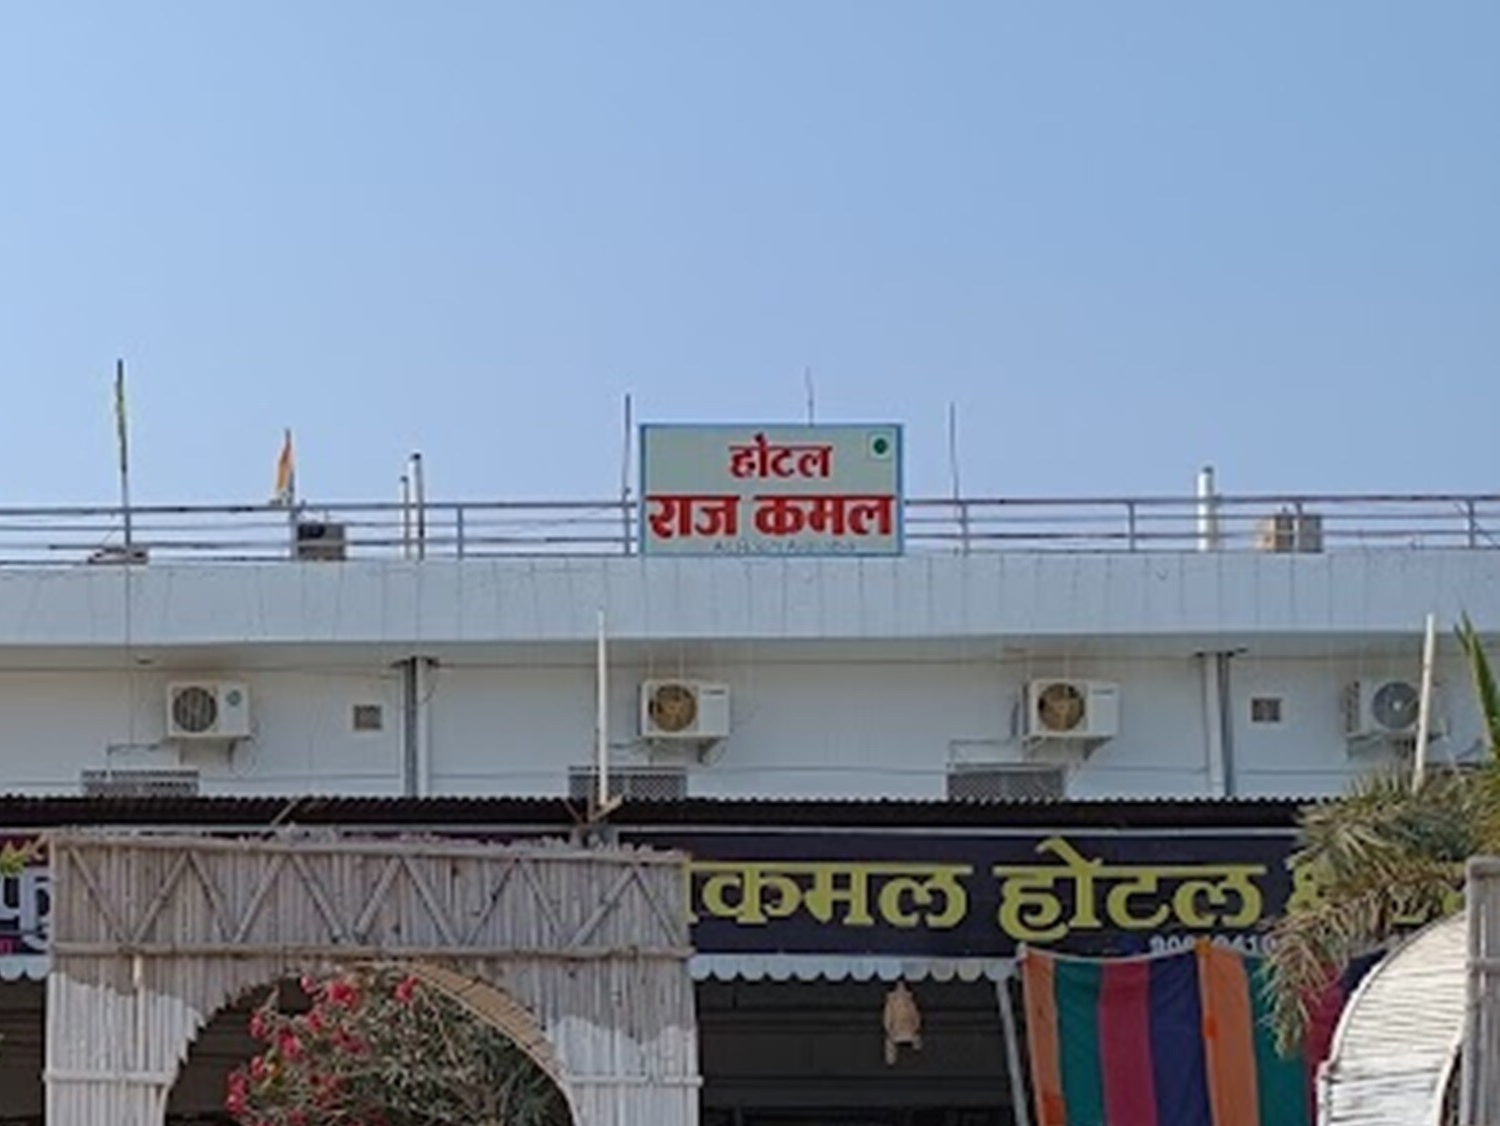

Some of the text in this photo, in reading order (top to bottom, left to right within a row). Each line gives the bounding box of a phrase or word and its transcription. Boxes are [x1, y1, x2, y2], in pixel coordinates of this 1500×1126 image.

[729, 432, 833, 478] होटल
[645, 494, 896, 539] राज कमल
[687, 861, 973, 930] कमल
[993, 836, 1266, 943] होटल
